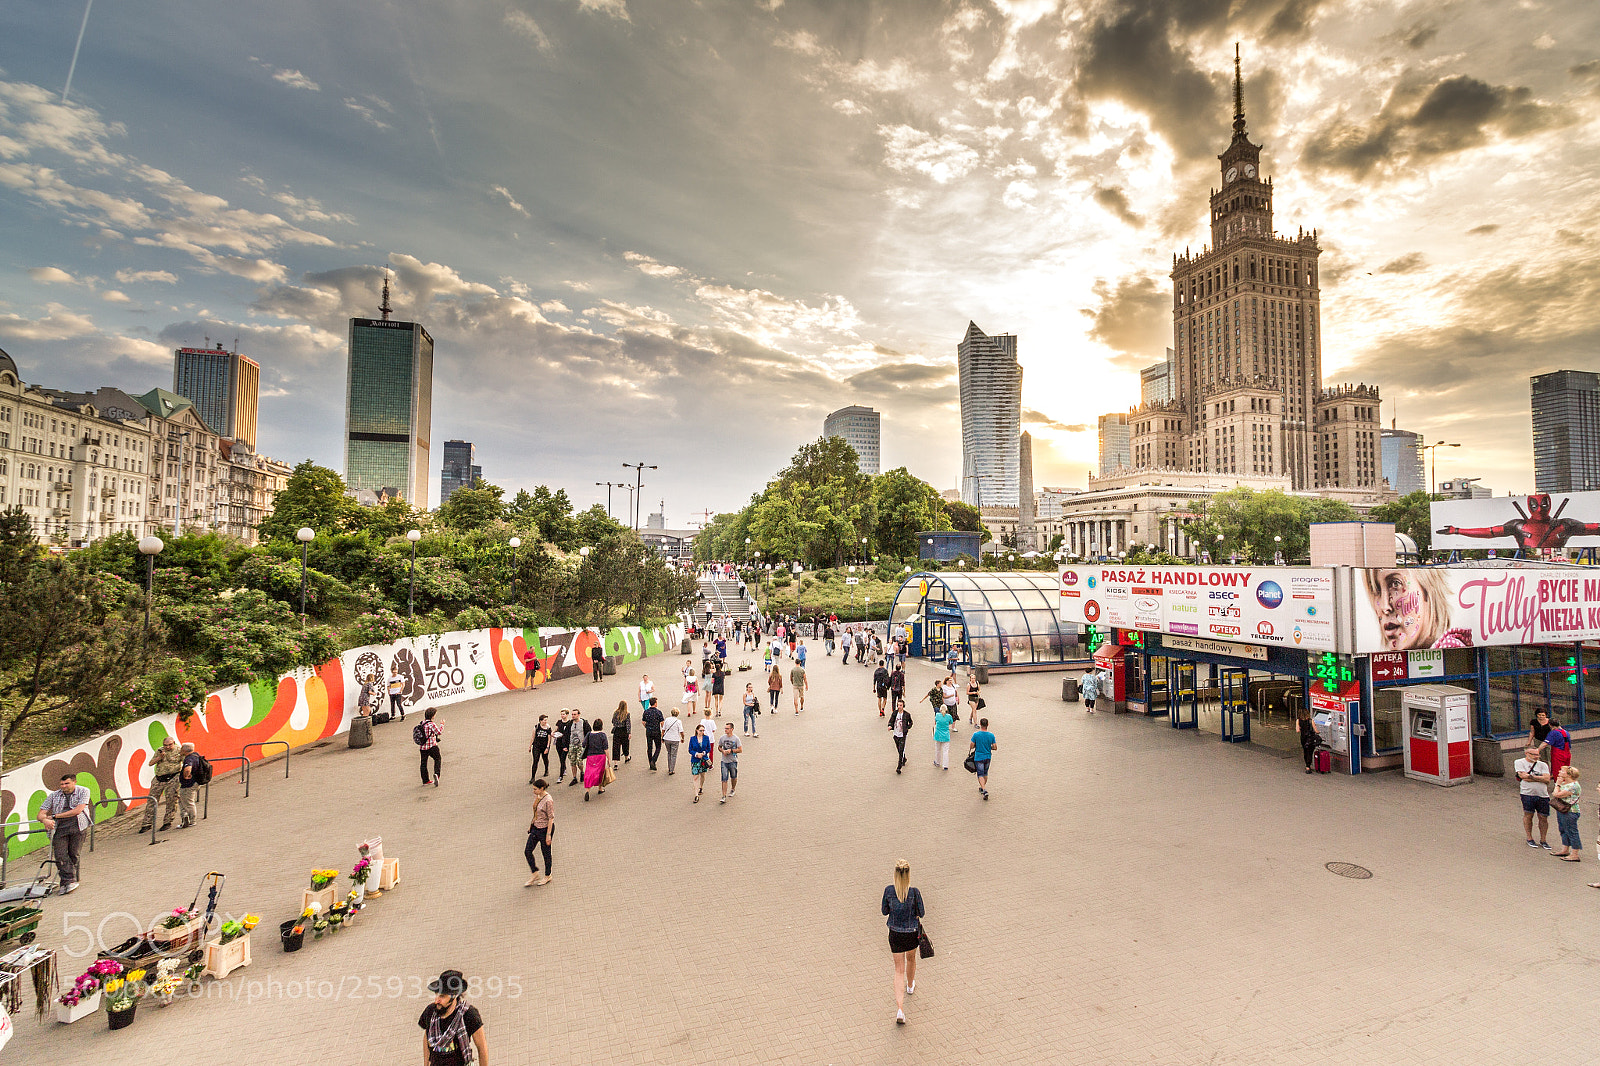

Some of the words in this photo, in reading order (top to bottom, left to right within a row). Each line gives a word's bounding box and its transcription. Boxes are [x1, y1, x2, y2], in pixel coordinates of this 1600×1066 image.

[1101, 568, 1145, 585] PASAŻ
[1151, 571, 1252, 588] HANDLOWY
[1257, 590, 1282, 599] Planet
[1540, 579, 1579, 603] BYCIE
[1172, 604, 1198, 613] natura
[1458, 571, 1542, 647] Tully
[1540, 608, 1584, 632] NIEZŁA
[1211, 625, 1240, 635] APTEKA
[1250, 634, 1285, 642] TELEFONY
[1171, 638, 1192, 648] pasaż
[1195, 641, 1234, 655] handlowy
[1373, 653, 1403, 663] APTEKA
[1410, 650, 1442, 665] natura
[425, 667, 465, 692] ZOO
[427, 686, 466, 701] WARSZAWA
